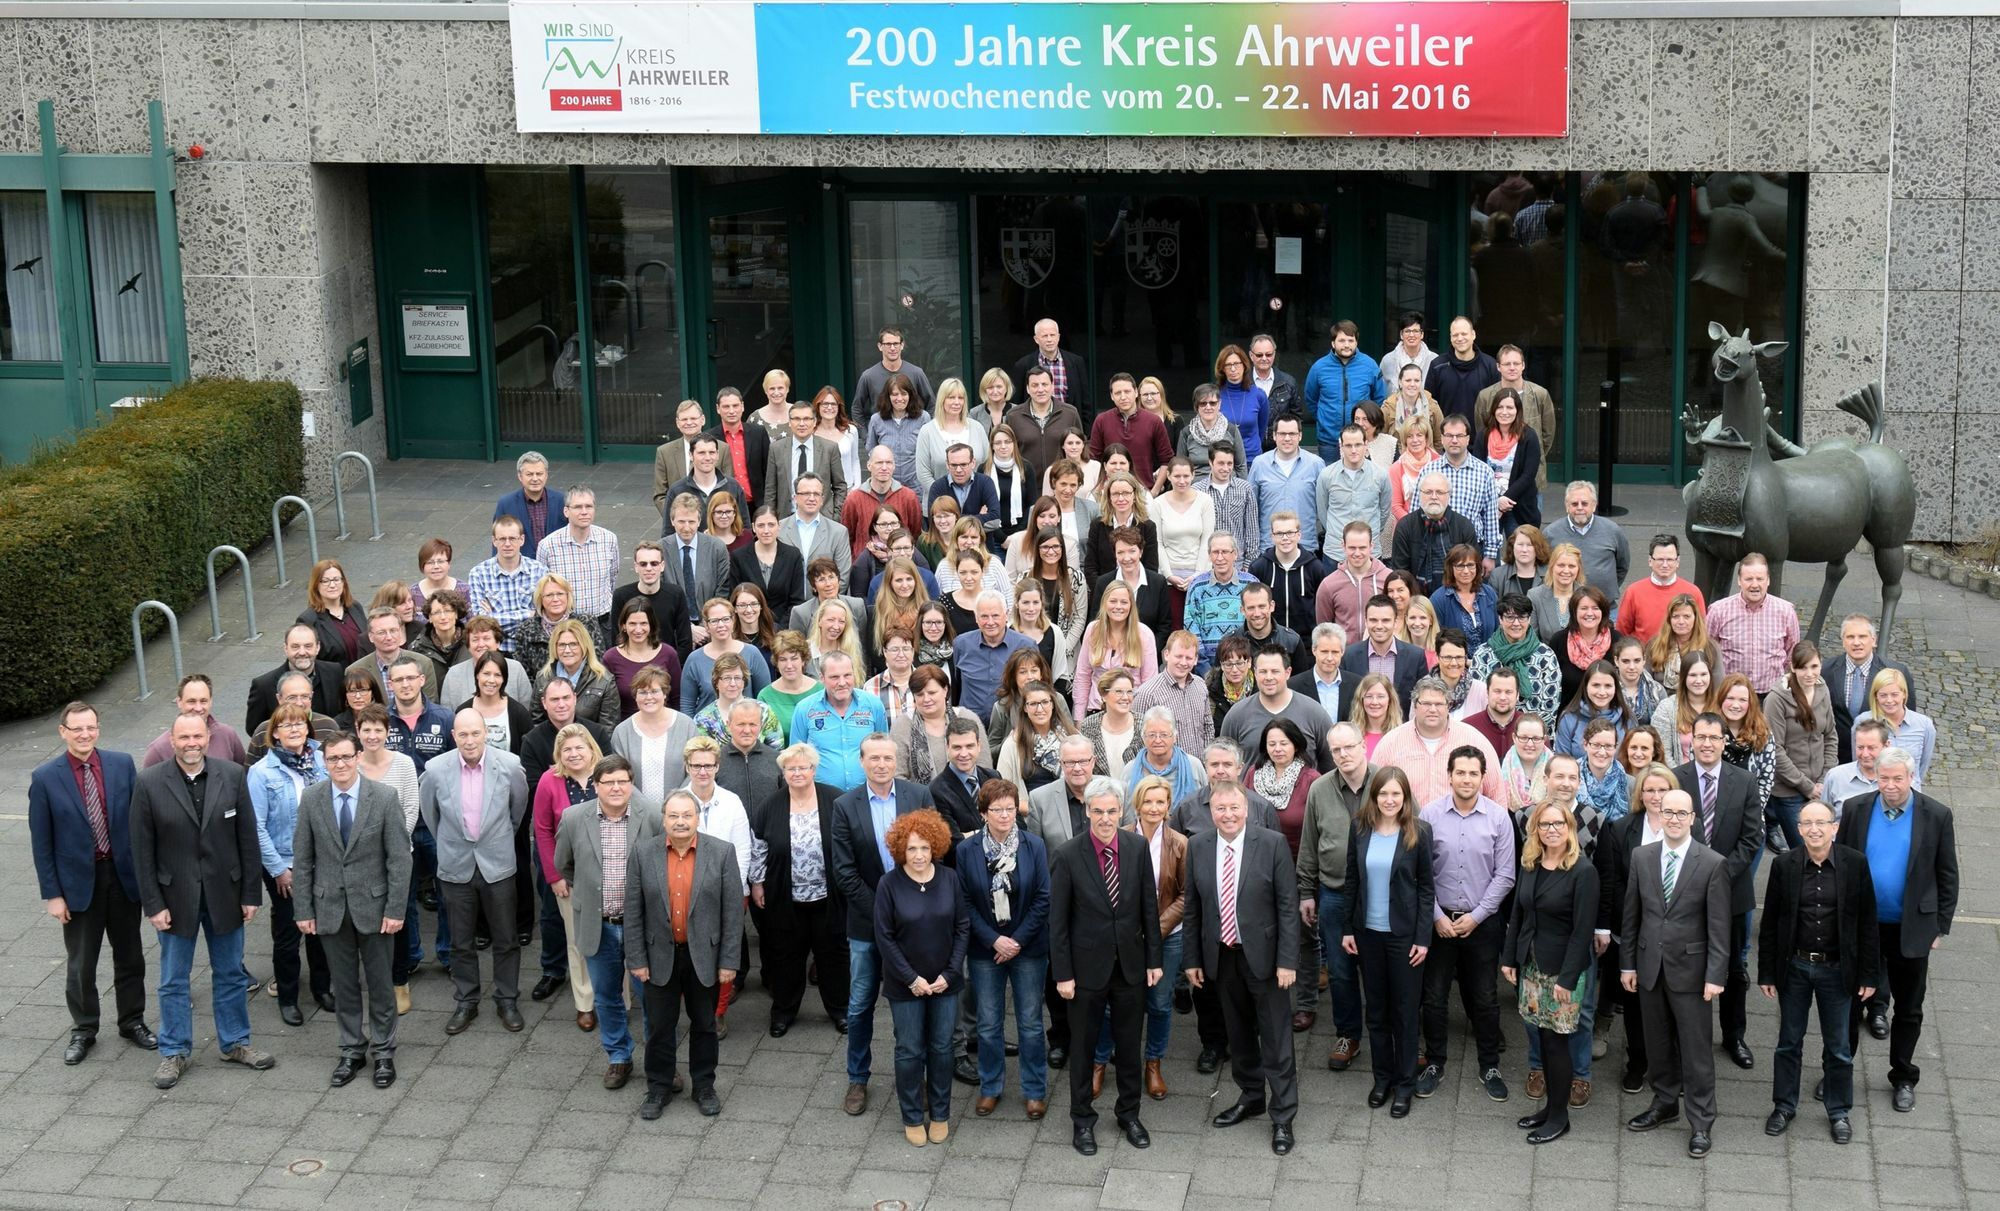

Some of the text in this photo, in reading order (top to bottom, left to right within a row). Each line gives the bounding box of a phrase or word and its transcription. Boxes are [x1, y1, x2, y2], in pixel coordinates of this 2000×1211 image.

[544, 24, 614, 37] WIR SIND
[846, 24, 1473, 67] 200 Jahre Kreis Ahrweiler
[627, 49, 676, 64] KREIS
[628, 70, 730, 86] AHRWEILER
[560, 96, 612, 106] 200 JAHRE
[629, 97, 650, 105] 1816
[660, 97, 682, 105] 2016
[849, 81, 1092, 109] Festwochenende
[1102, 89, 1164, 109] vom
[1175, 84, 1222, 110] 20.
[1262, 84, 1309, 110] 22.
[1322, 82, 1379, 110] Mai
[1391, 84, 1471, 110] 2016
